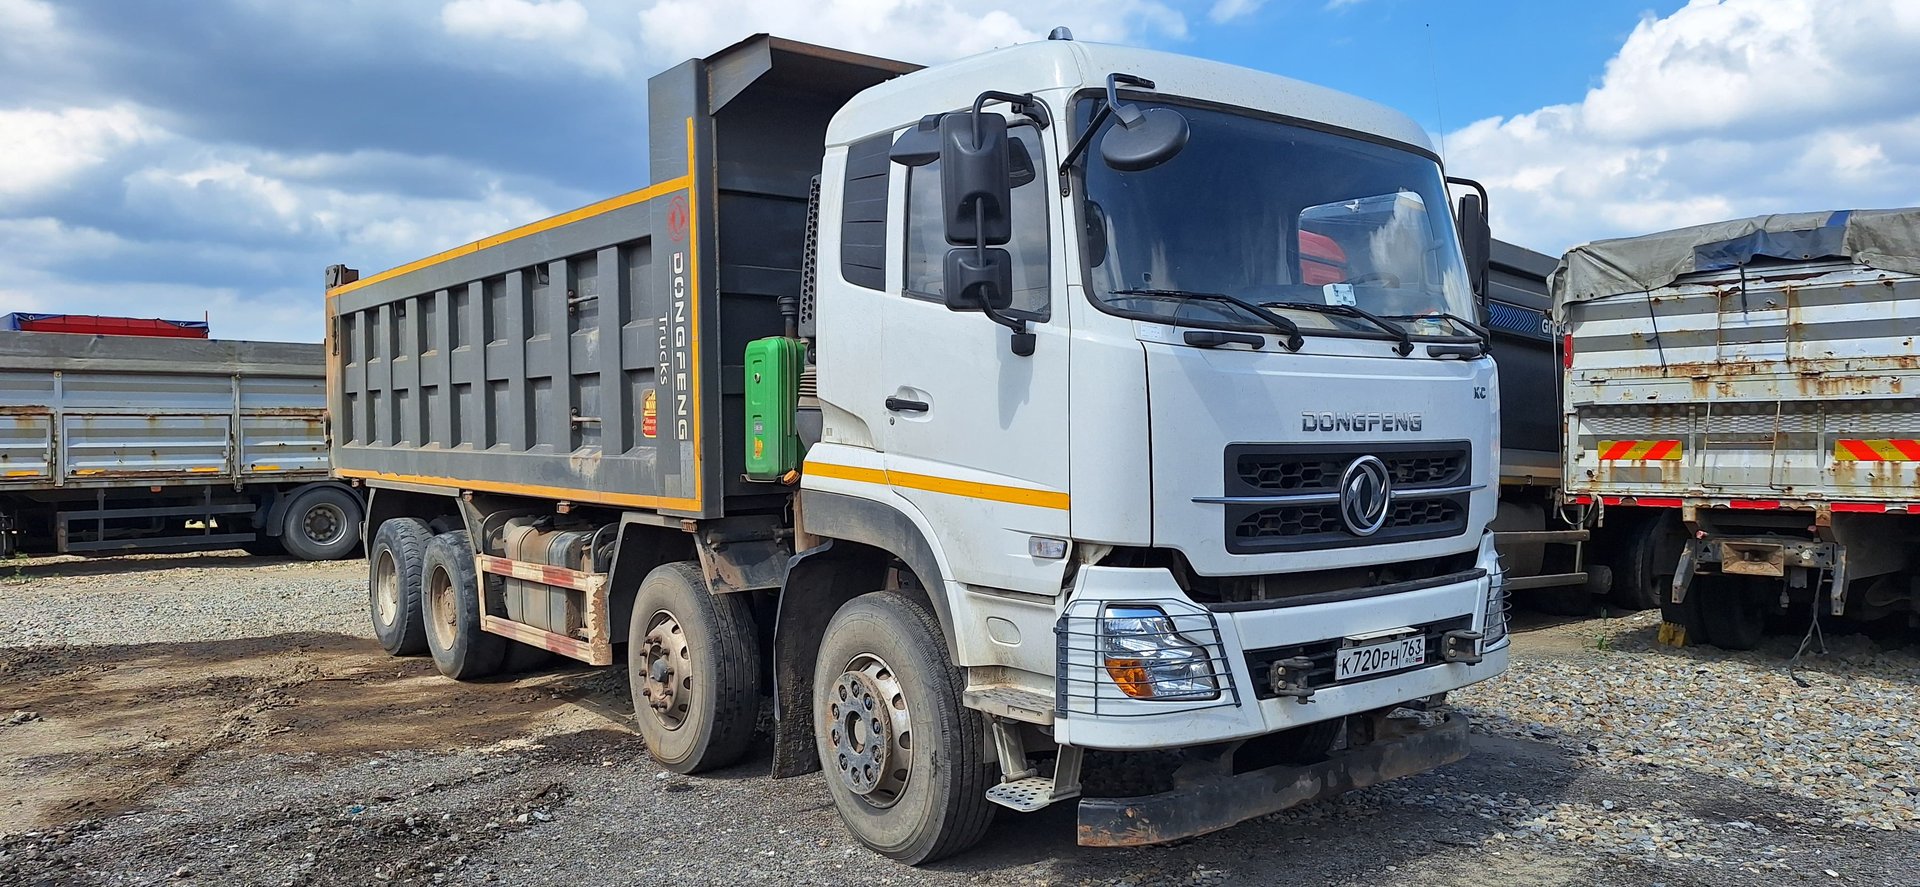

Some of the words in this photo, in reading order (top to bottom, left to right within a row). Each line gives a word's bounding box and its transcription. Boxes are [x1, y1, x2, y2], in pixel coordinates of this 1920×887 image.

[658, 311, 670, 386] Trucks
[673, 251, 688, 440] DONGFENG
[1301, 411, 1422, 432] DONGFENG
[1402, 638, 1422, 659] 763
